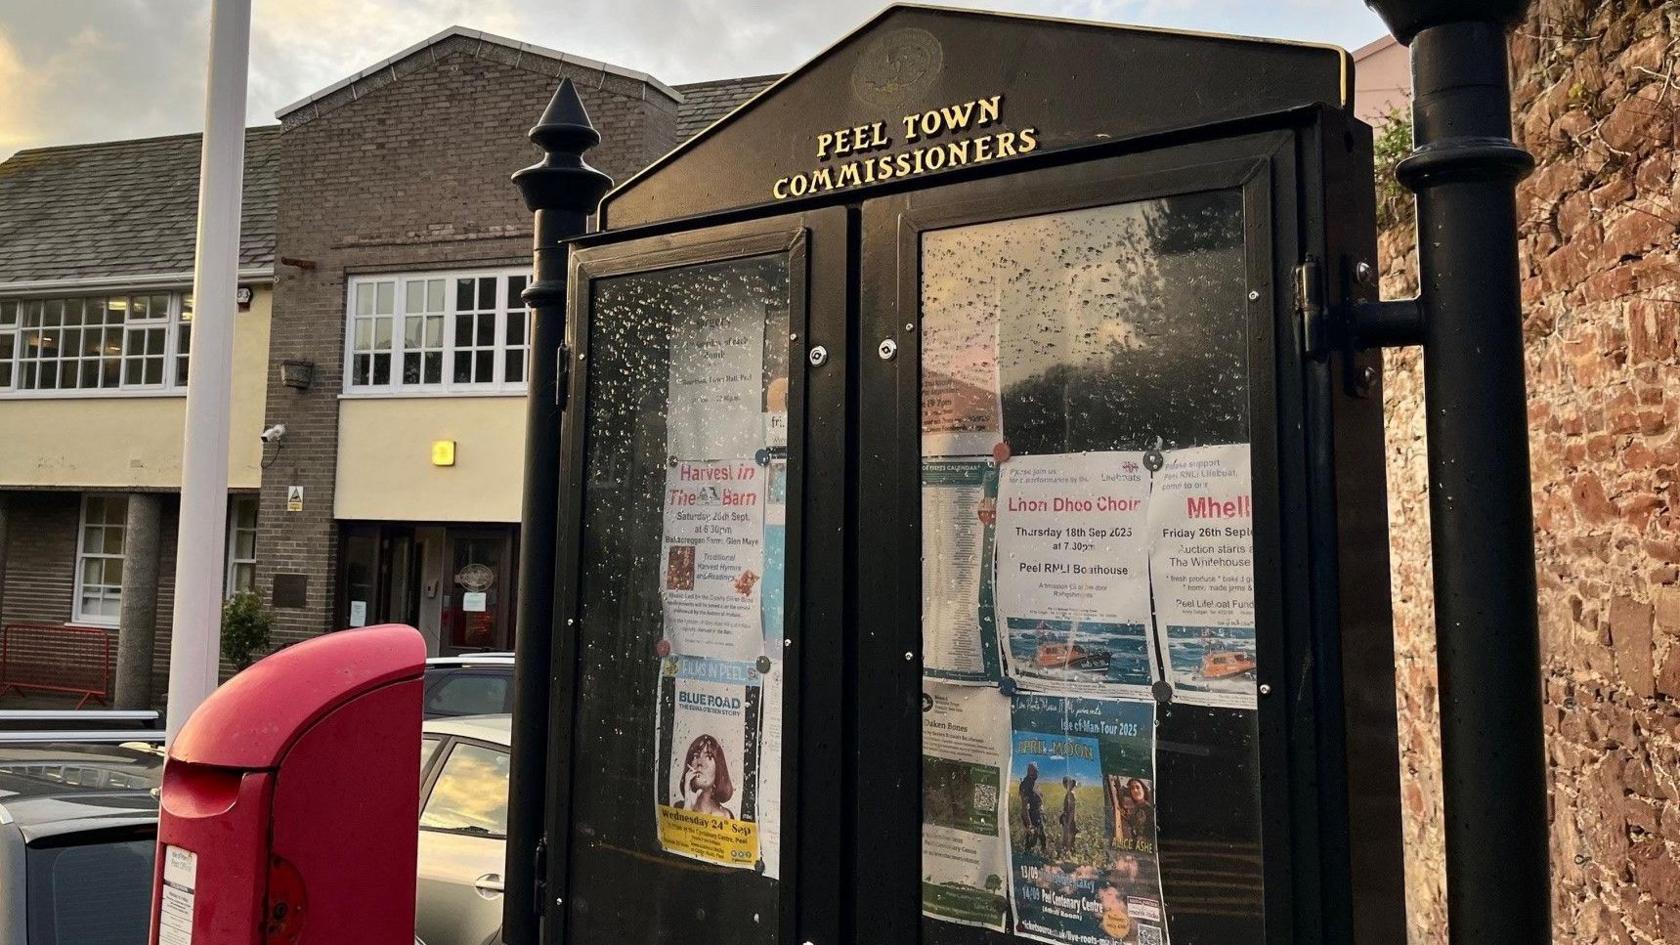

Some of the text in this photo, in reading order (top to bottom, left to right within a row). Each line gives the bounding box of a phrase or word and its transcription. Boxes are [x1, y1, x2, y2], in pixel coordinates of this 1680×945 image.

[816, 95, 1001, 158] PEEL TOWN
[773, 128, 1037, 200] COMMISSIONERS
[680, 463, 755, 481] Harvest in
[669, 488, 757, 506] The Barn
[1054, 497, 1092, 512] Dhoo
[1096, 496, 1142, 512] Choir
[1015, 526, 1133, 540] Thursday 18th Sep 2025
[1162, 528, 1196, 540] Friday
[1199, 528, 1222, 538] 26th
[1052, 543, 1061, 551] at
[1217, 544, 1246, 554] starts
[1020, 562, 1042, 573] Peel
[1169, 558, 1188, 568] The
[1176, 599, 1195, 608] Peel
[682, 658, 708, 676] FILMS
[719, 663, 747, 681] PEEL
[1100, 721, 1118, 735] Tour
[1119, 722, 1138, 737] 2025
[662, 808, 710, 829] Wednesday
[732, 824, 752, 836] Sep
[1052, 892, 1082, 914] Centenary
[1082, 896, 1104, 914] Centre
